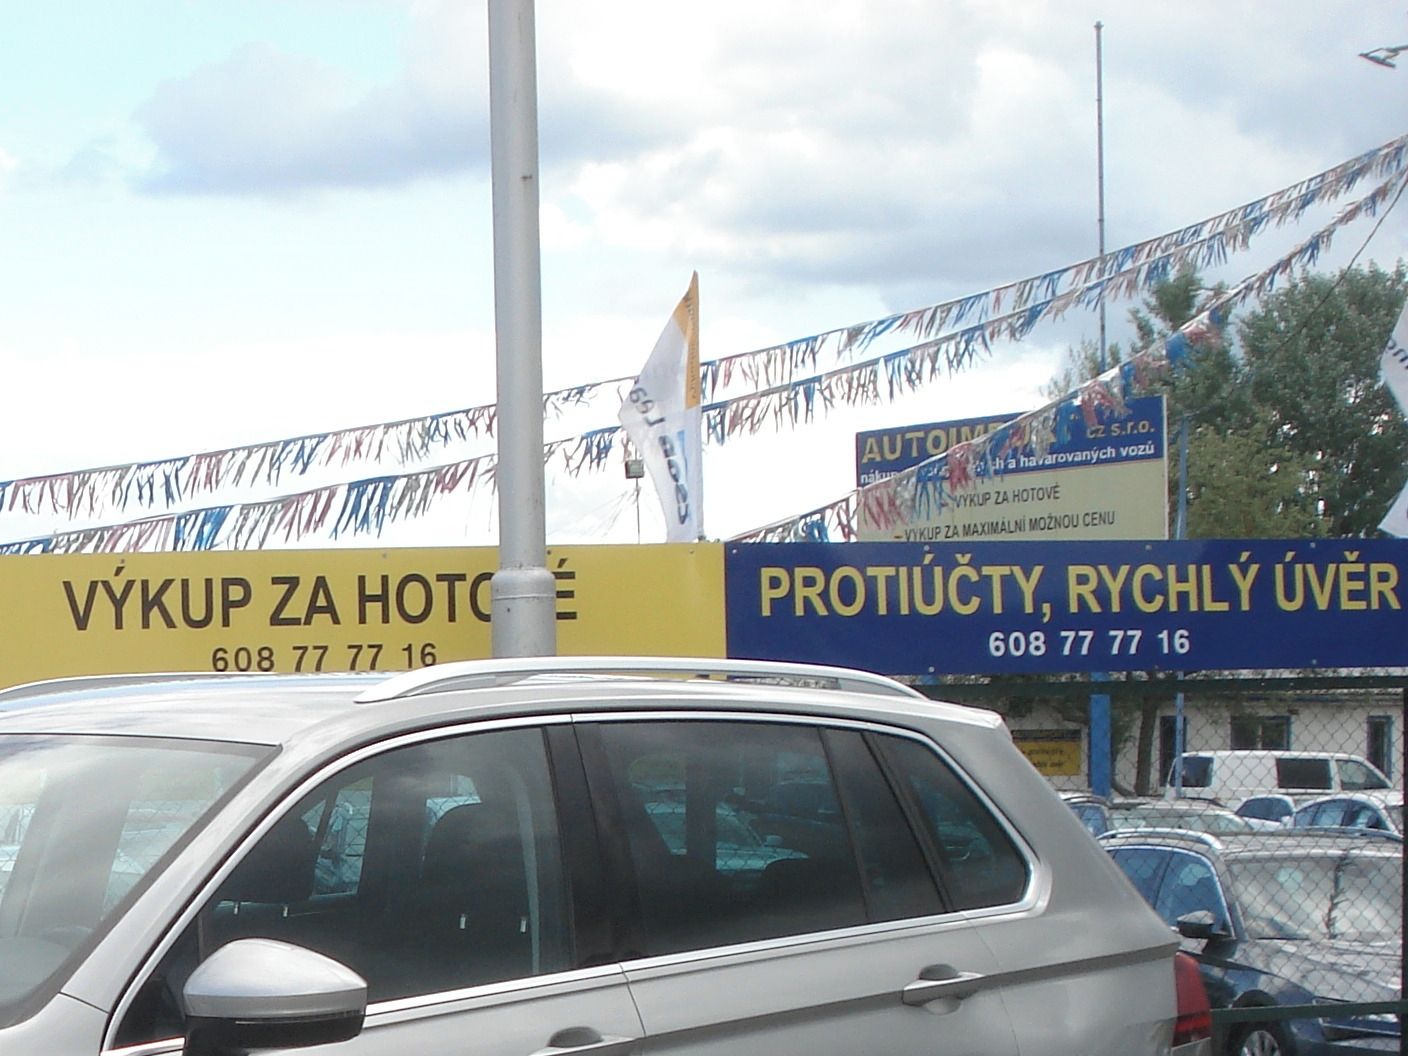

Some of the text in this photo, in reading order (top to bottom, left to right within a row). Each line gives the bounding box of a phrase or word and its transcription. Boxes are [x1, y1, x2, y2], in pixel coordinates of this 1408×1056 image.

[1111, 420, 1155, 437] s.r.o.
[994, 490, 1009, 505] ZA
[944, 524, 959, 539] ZA
[1082, 511, 1116, 527] CENU
[63, 558, 578, 632] VÝKUP ZA HOTOÉ
[760, 551, 1402, 624] PROTIÚČTY, RYCHLÝ ÚVĚR
[211, 642, 437, 673] 608 77 77 16
[989, 628, 1190, 658] 608 77 77 16
